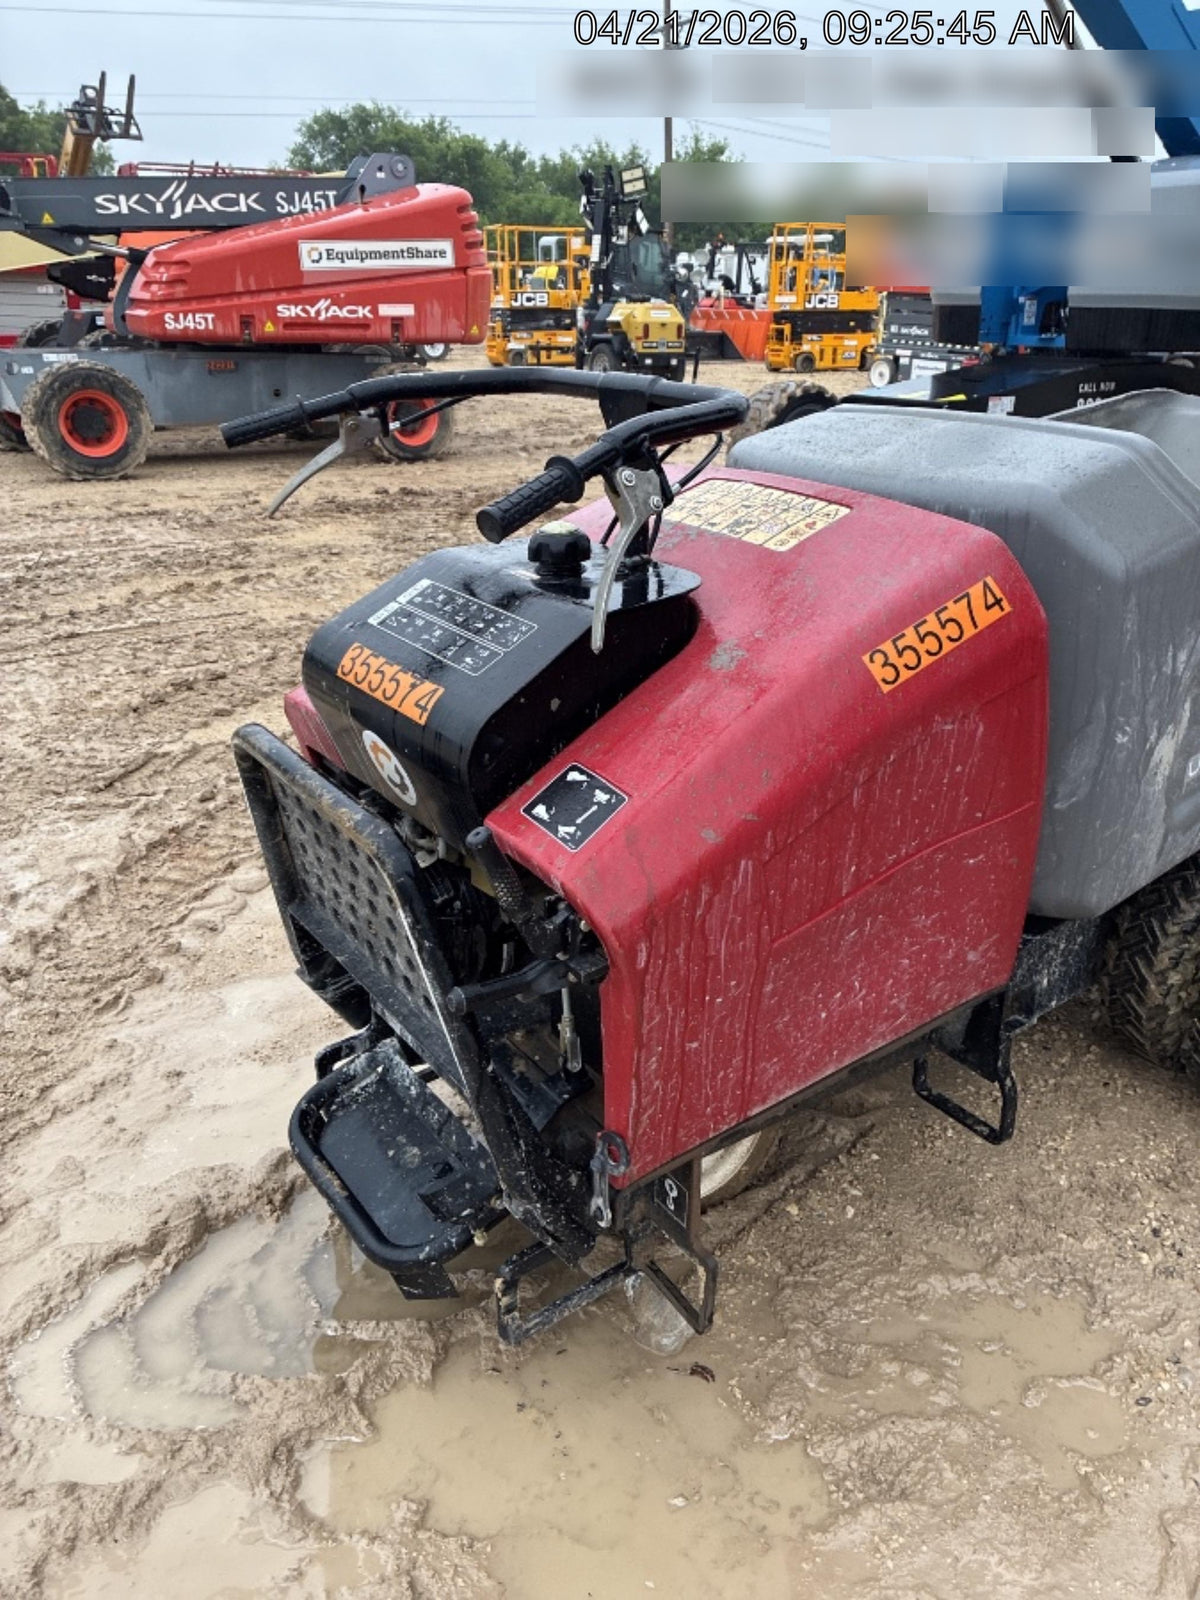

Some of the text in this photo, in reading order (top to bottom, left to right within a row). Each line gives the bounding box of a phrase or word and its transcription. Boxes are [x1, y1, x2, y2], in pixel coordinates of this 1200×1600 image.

[93, 180, 338, 219] SKYJACK SJ45T
[325, 246, 448, 264] EquipmentShare
[511, 292, 549, 307] JCB
[804, 294, 840, 309] JCB
[276, 298, 374, 320] SKYJACK
[164, 313, 216, 331] SJ45T
[1078, 382, 1097, 394] CALL
[868, 579, 1006, 686] 355574
[339, 645, 441, 721] 355574
